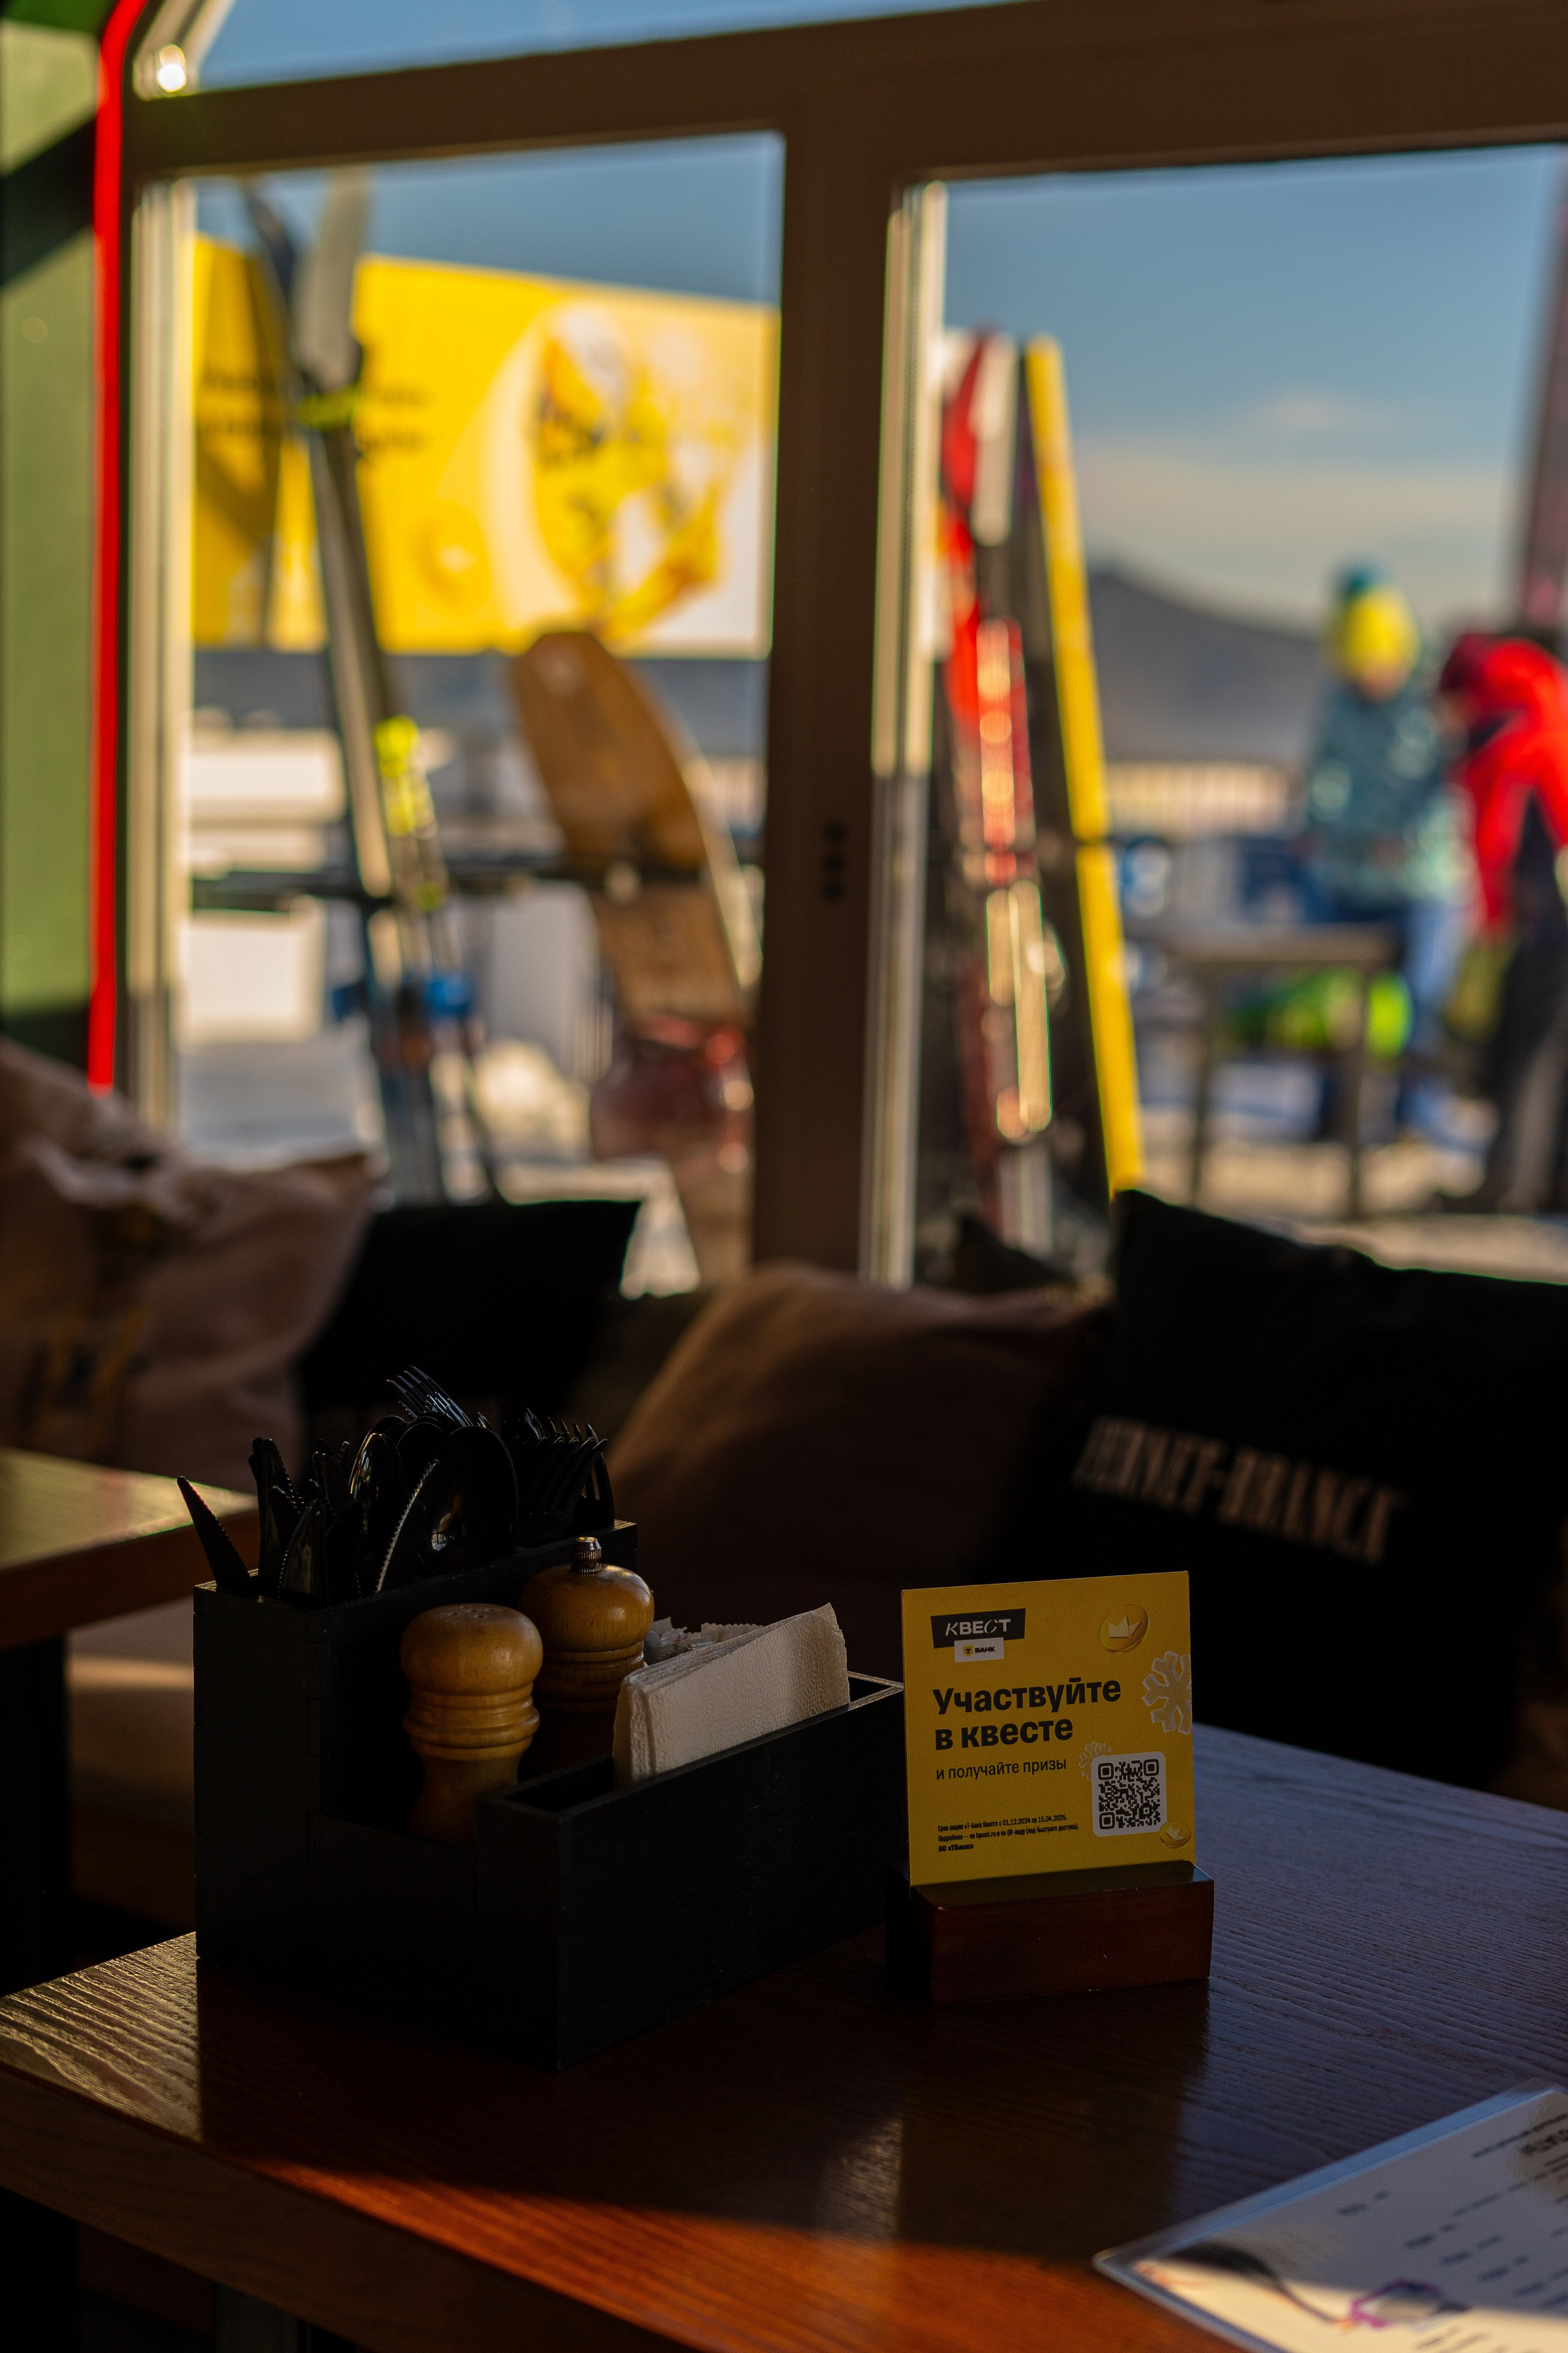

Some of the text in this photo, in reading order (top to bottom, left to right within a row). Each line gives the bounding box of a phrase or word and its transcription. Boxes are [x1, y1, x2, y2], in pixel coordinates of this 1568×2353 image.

[945, 1618, 1011, 1636] КВЕСТ
[932, 1677, 1121, 1715] Участвуйте
[935, 1718, 1073, 1750] в квесте
[936, 1758, 1067, 1780] и получайте призы
[1003, 1817, 1031, 1826] 01.12.2024
